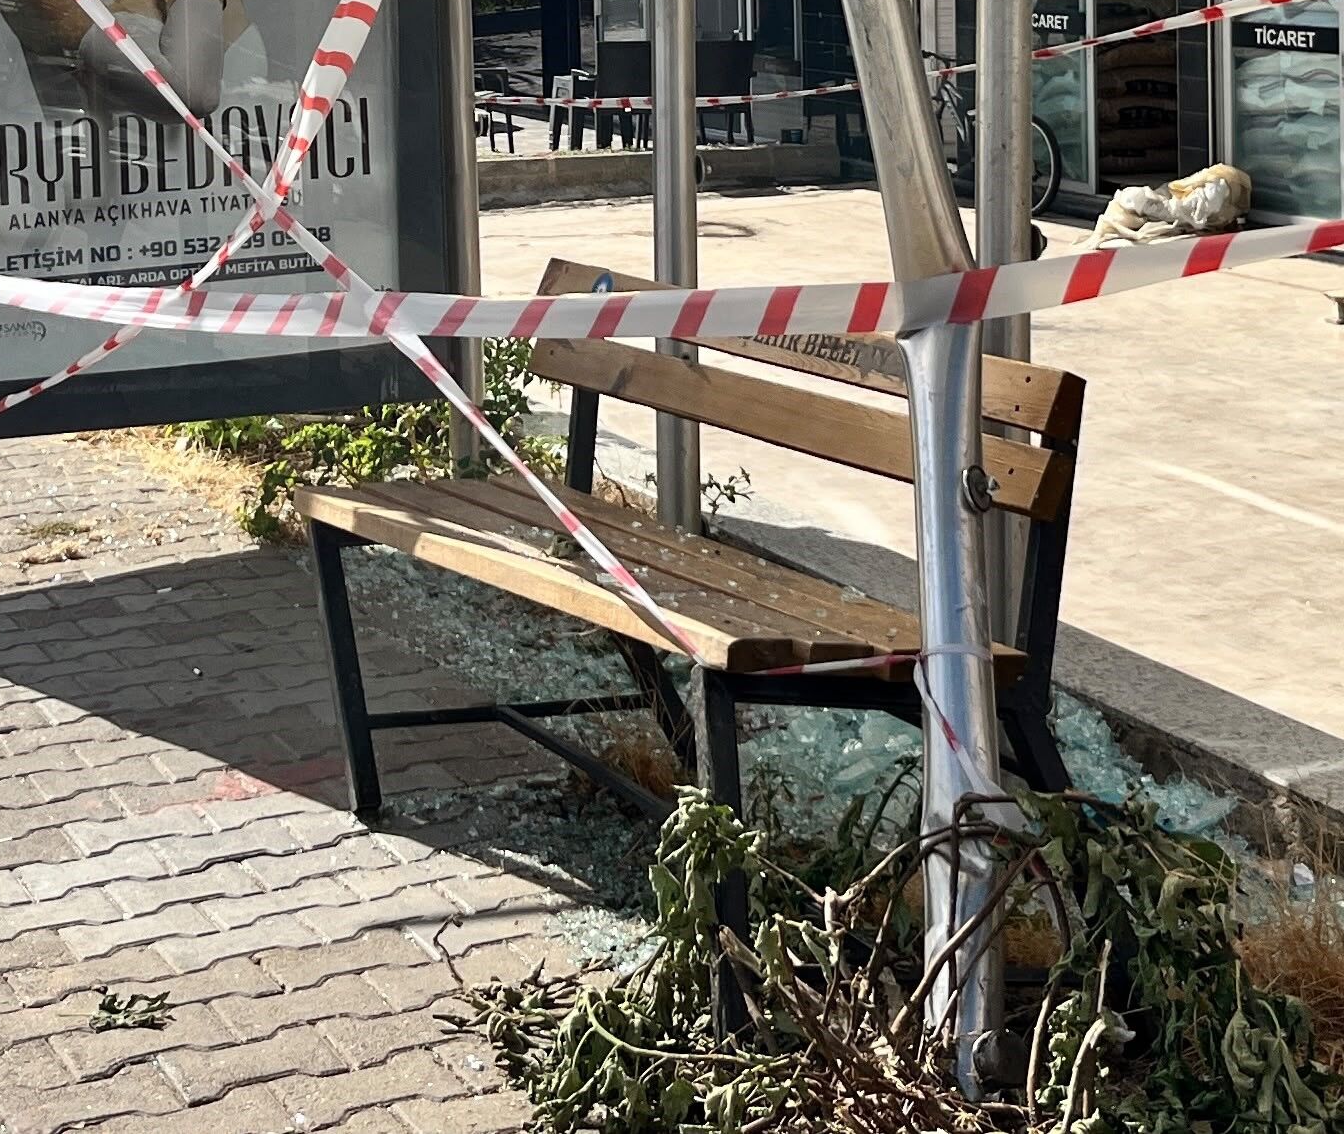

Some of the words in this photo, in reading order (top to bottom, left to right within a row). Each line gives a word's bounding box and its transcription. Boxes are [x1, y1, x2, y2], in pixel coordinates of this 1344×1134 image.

[1254, 25, 1316, 48] TİCARET
[9, 208, 86, 231] ALANYA
[94, 198, 192, 227] AÇIKHAVA
[90, 244, 121, 263] NO
[139, 239, 177, 258] +90
[183, 236, 221, 254] 532
[129, 270, 167, 284] ARDA
[225, 258, 276, 275] MEFİTA
